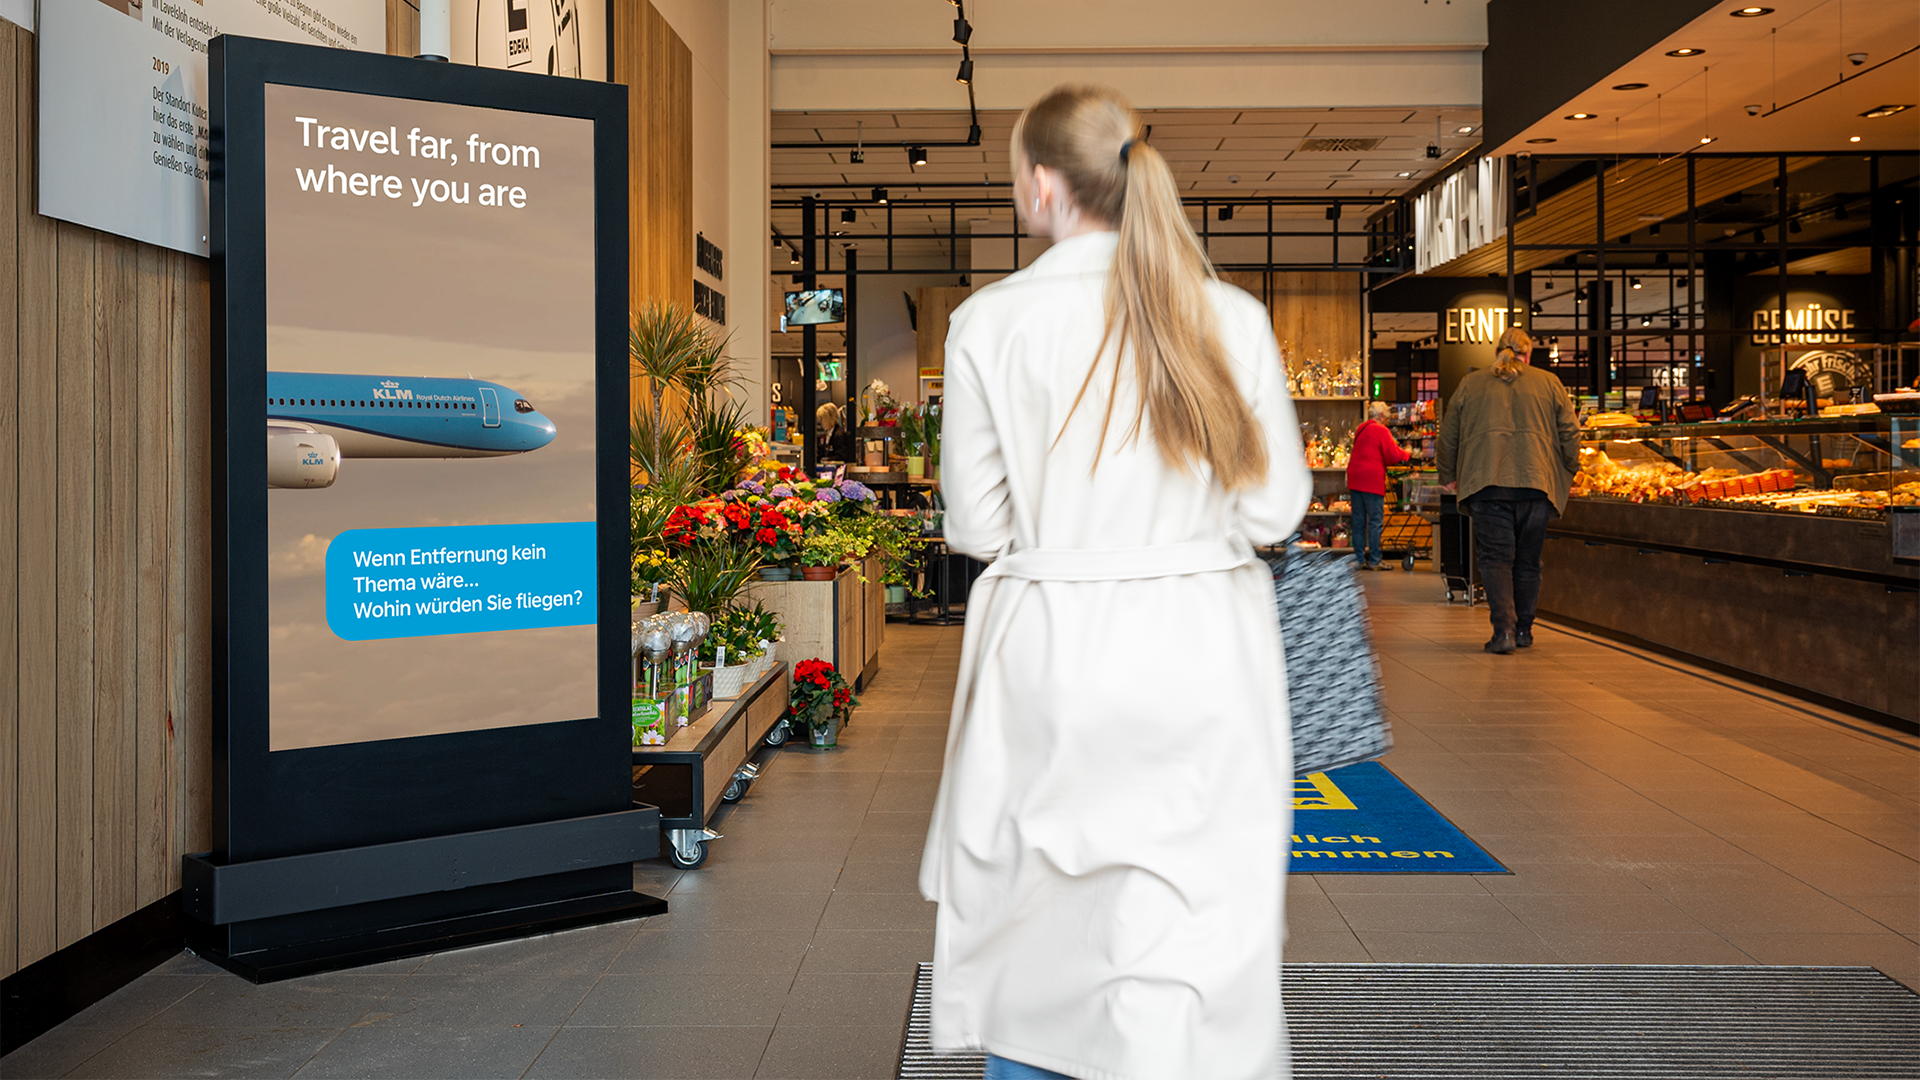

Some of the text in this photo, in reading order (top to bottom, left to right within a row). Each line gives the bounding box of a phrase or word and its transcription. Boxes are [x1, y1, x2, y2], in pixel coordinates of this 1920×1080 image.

[189, 16, 213, 37] entsteht
[300, 20, 307, 32] an
[321, 16, 328, 27] es
[152, 16, 208, 54] Mit der Verlagerun
[508, 37, 530, 56] EDEKA
[152, 56, 170, 75] 2019
[152, 86, 164, 103] Der
[165, 91, 191, 114] Standort
[152, 106, 166, 125] hier
[166, 112, 178, 129] das
[178, 119, 194, 136] erste
[153, 131, 161, 144] zu
[162, 133, 185, 153] wählen
[186, 142, 197, 157] und
[294, 116, 541, 169] Travel far, from
[153, 150, 183, 173] Genießen
[183, 161, 193, 177] Sie
[294, 164, 528, 209] where you are
[1752, 303, 1856, 344] GEMÜSE
[372, 388, 414, 400] KLM
[416, 393, 433, 402] Royal
[433, 394, 452, 402] Dutch
[302, 458, 324, 466] KLM
[353, 543, 547, 568] Wenn Entfernung kein
[353, 572, 479, 593] Thema wäre...
[353, 590, 583, 619] Wohin würden Sie fliegen?
